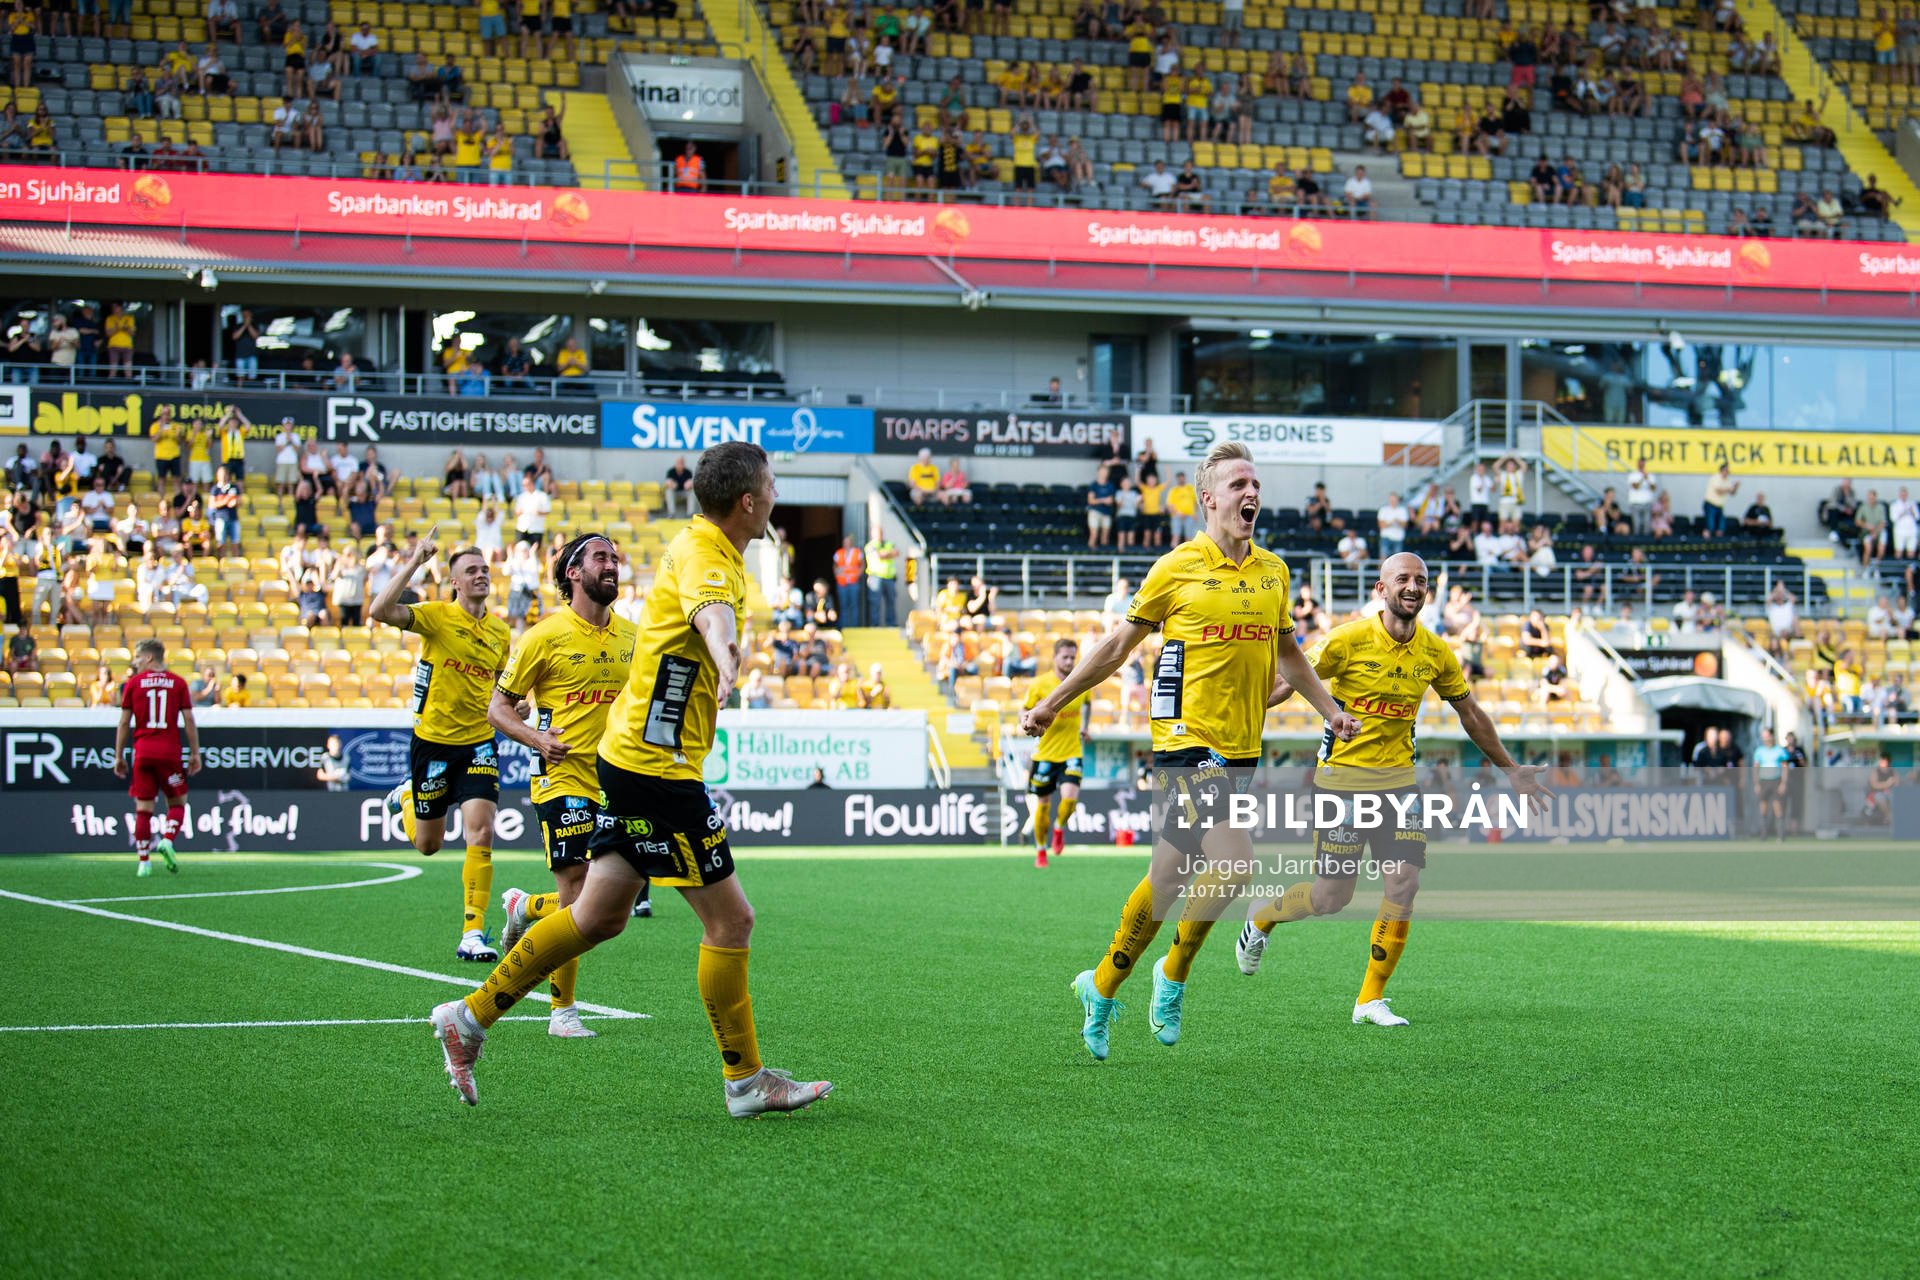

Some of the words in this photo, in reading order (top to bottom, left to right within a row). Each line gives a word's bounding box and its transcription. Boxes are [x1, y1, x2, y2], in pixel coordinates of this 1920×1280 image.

[26, 179, 120, 205] Sjuhärad
[327, 191, 448, 217] Sparbanken
[452, 195, 542, 221] Sjuhärad
[724, 207, 837, 234] Sparbanken
[840, 211, 925, 238] Sjuhärad
[1087, 222, 1196, 249] Sparbanken
[1199, 225, 1280, 252] Sjuhärad
[1551, 240, 1652, 267] Sparbanken
[1655, 243, 1731, 269] Sjuhärad
[327, 397, 380, 441] FR
[380, 410, 597, 435] FASTIGHETSSERVICE
[631, 403, 767, 449] SILVENT
[882, 417, 970, 442] TOARPS
[1227, 423, 1334, 444] S2BONES
[1605, 439, 1690, 462] STORT
[1700, 442, 1764, 464] TACK
[1775, 443, 1828, 465] TILL
[1837, 446, 1898, 467] ALLA
[146, 689, 168, 729] 11
[565, 690, 621, 706] PULS
[1351, 697, 1417, 718] PULSEN
[736, 732, 871, 756] Hållanders
[6, 733, 70, 784] FR
[835, 761, 871, 780] AB
[418, 801, 430, 814] 15
[729, 801, 794, 837] flow!
[71, 804, 118, 836] the
[197, 805, 224, 836] of
[229, 803, 299, 841] flow!
[558, 842, 567, 857] 7
[711, 848, 723, 868] 6
